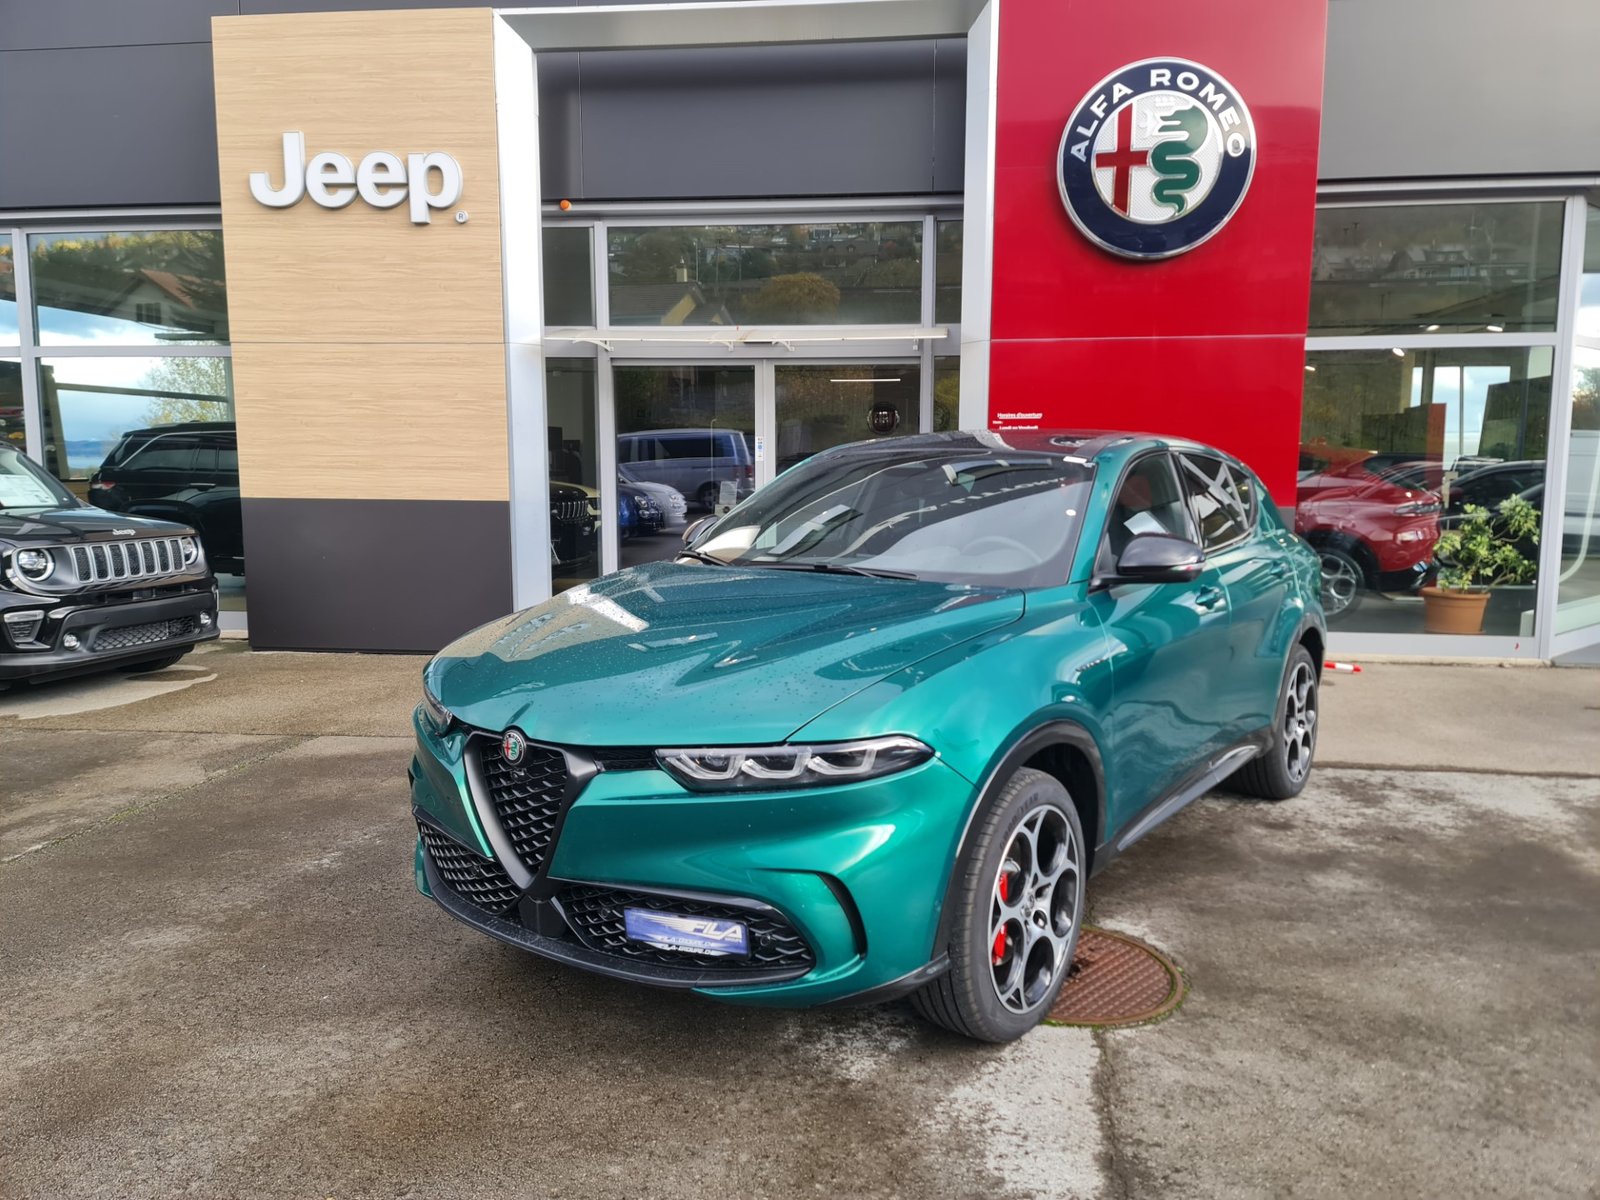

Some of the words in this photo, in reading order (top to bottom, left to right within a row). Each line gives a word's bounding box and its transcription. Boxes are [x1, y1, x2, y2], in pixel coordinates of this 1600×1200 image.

[1070, 81, 1134, 163] ALFA
[1150, 68, 1246, 158] ROMEO
[249, 130, 464, 225] Jeep
